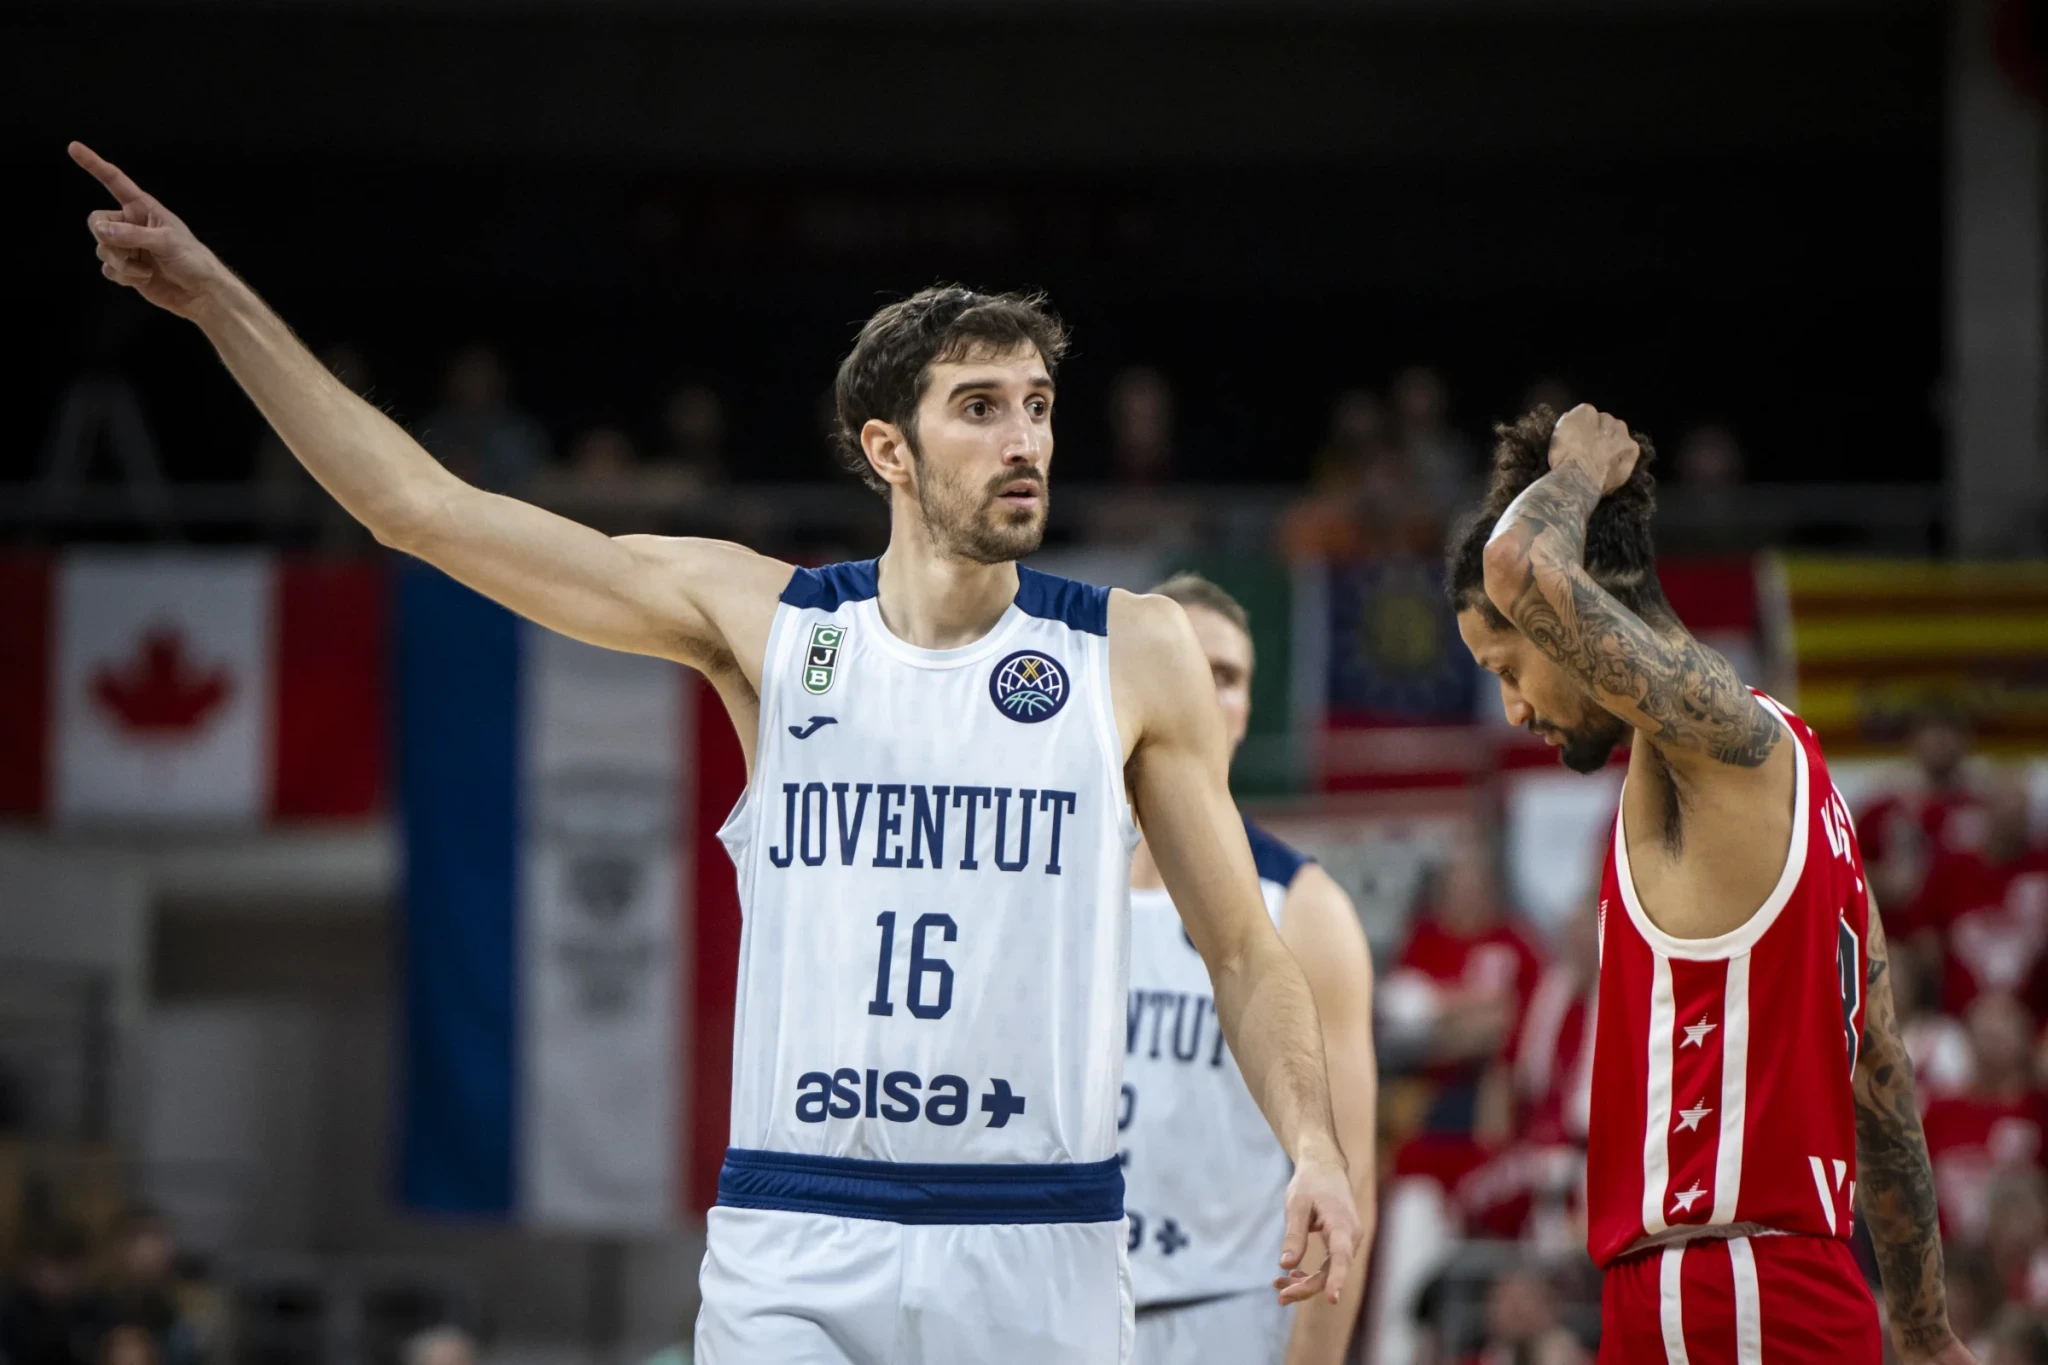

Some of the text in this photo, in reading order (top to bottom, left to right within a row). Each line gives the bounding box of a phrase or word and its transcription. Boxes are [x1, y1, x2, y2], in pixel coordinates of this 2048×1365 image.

[769, 782, 1077, 875] JOVENTUT
[868, 910, 958, 1020] 16
[795, 1067, 969, 1126] asisa
